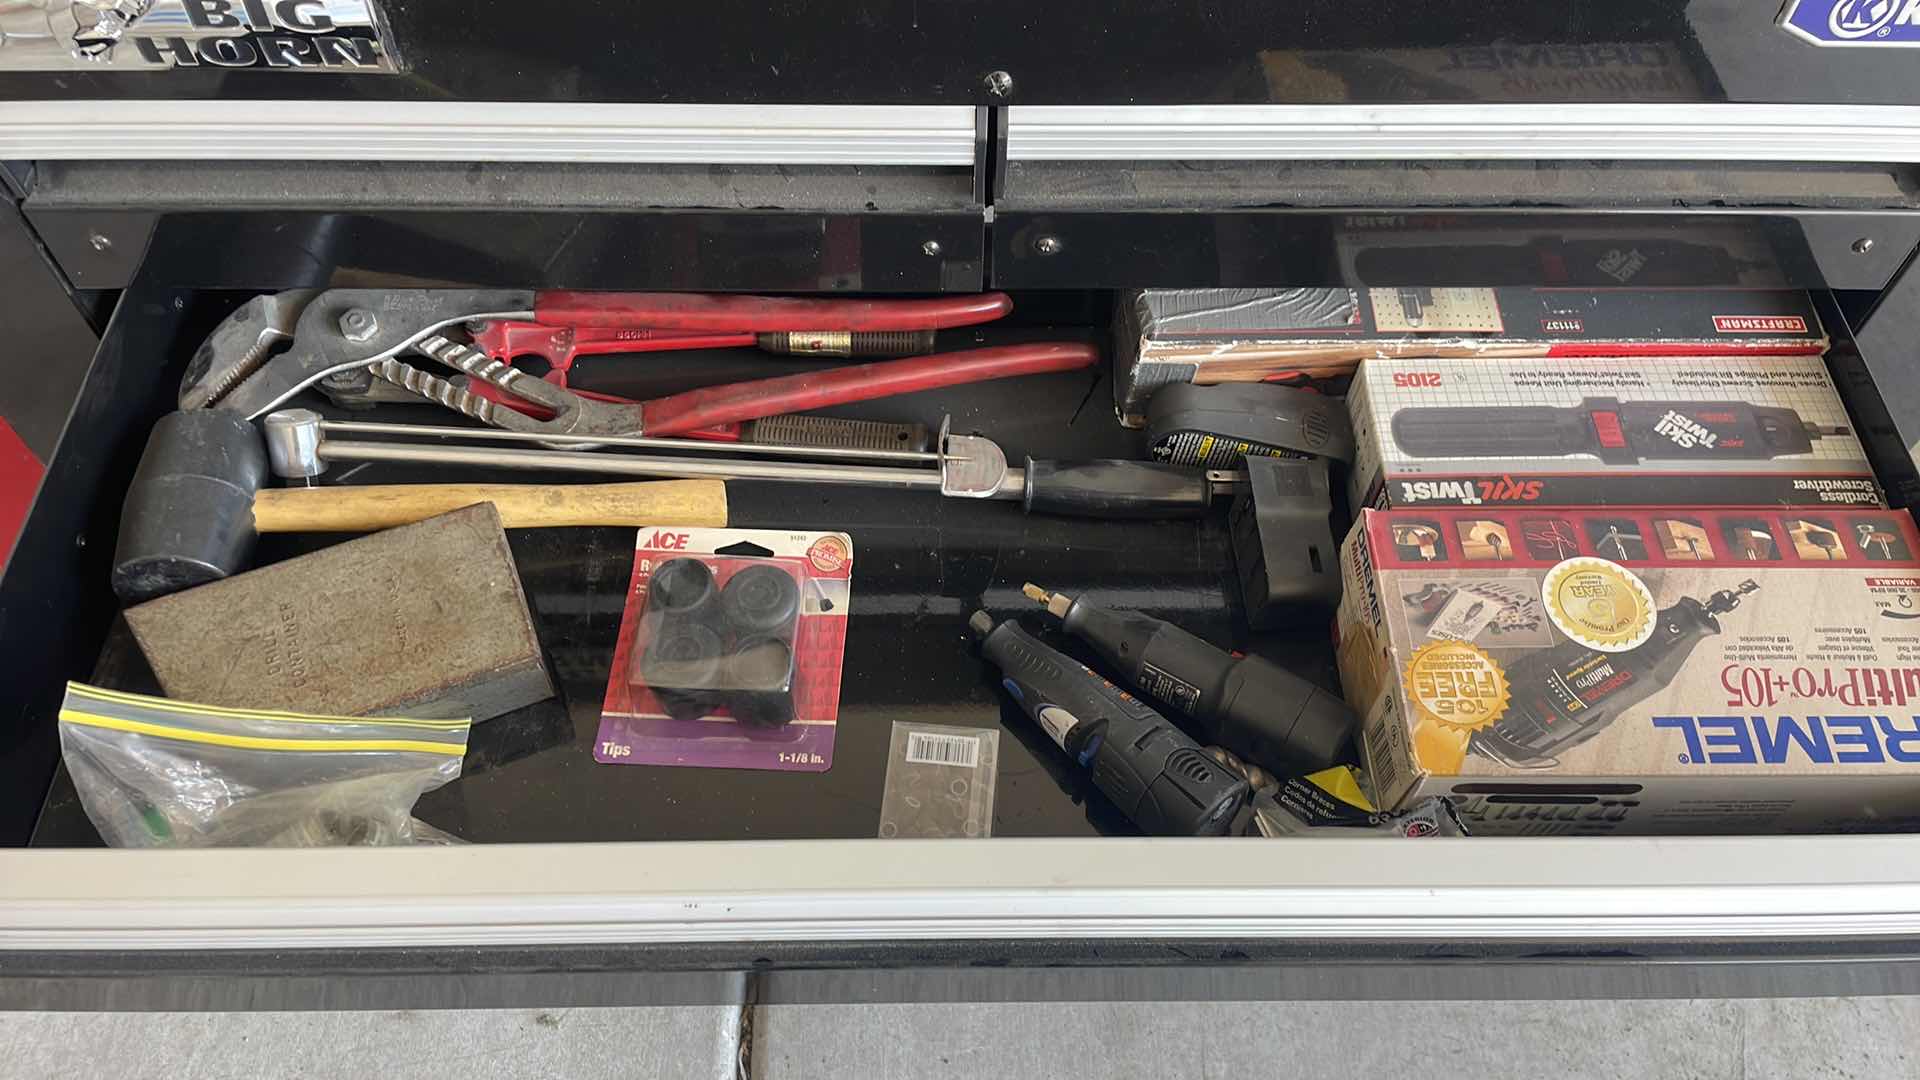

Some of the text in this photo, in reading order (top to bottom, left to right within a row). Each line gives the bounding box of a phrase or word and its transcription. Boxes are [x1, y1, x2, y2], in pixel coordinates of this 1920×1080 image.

[183, 0, 336, 33] BIG
[135, 37, 381, 67] HORN
[1718, 319, 1803, 331] CRAFTSMAN
[1392, 373, 1442, 387] 2105
[1513, 379, 1542, 388] Keeps
[1563, 379, 1615, 388] Recharging
[1616, 379, 1645, 388] Handy
[1653, 419, 1698, 449] Skil
[1478, 474, 1544, 501] SKIL
[1793, 480, 1873, 492] Screwdriver
[1820, 491, 1879, 504] Cordless
[643, 530, 690, 550] ACE
[1569, 585, 1612, 598] YEAR
[263, 630, 281, 676] DRILL
[1416, 672, 1497, 698] FREE
[1434, 699, 1488, 715] 105
[602, 742, 631, 758] Tips
[779, 752, 808, 764] 1-1/8
